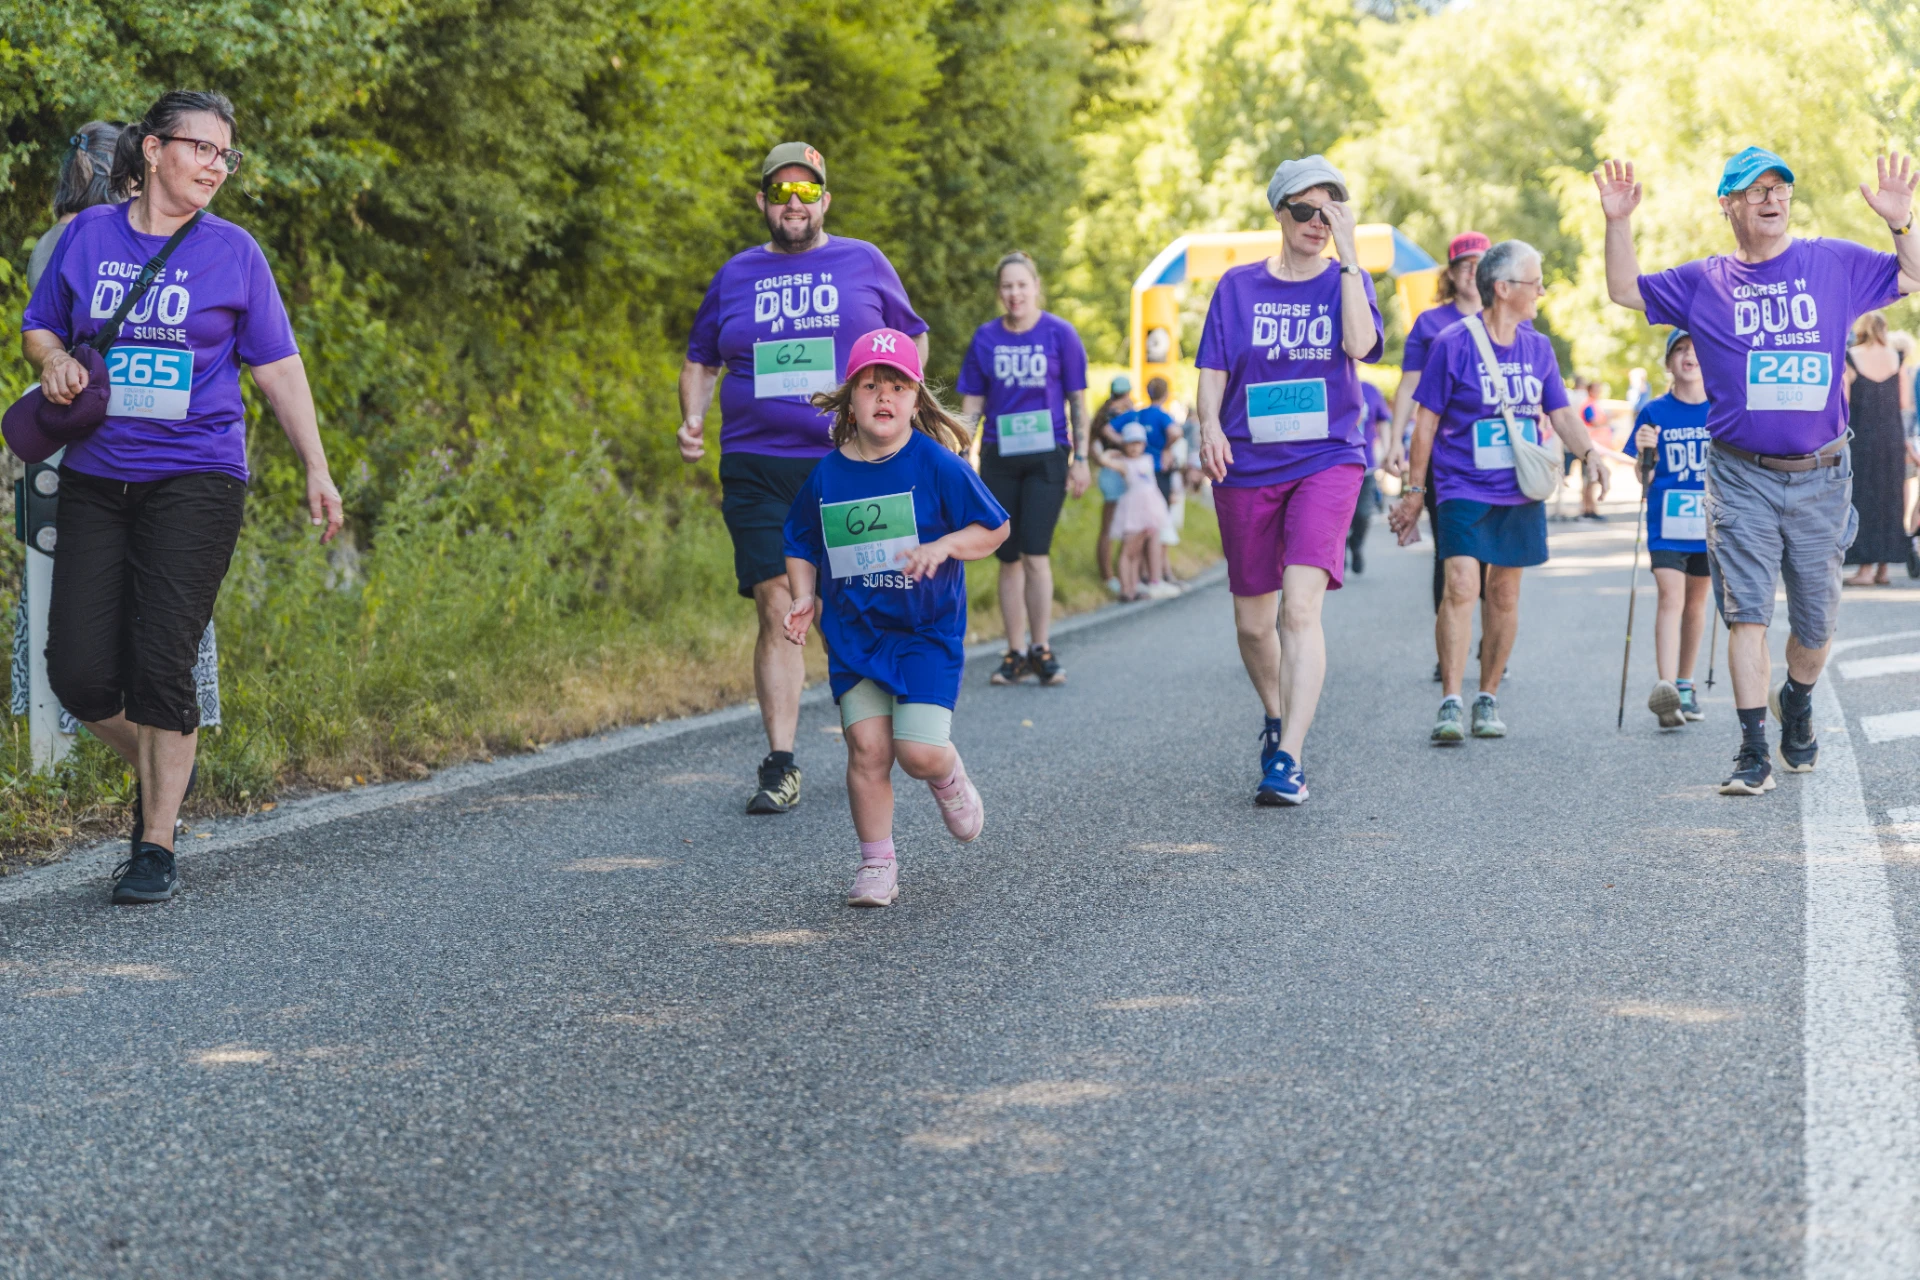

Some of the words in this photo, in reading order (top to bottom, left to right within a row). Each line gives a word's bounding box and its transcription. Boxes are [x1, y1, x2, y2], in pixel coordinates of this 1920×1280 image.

[98, 261, 166, 283] COURE
[755, 273, 813, 291] COURSE
[1733, 281, 1788, 299] COURSE
[90, 280, 190, 326] DUO
[755, 284, 839, 323] DUO
[1254, 303, 1311, 317] COURSE
[793, 314, 840, 331] SUISSE
[1735, 293, 1818, 335] DUO
[133, 326, 187, 343] SUISSE
[1252, 315, 1332, 349] DUO
[1775, 330, 1820, 346] SUISSE
[871, 333, 897, 353] NY
[776, 343, 812, 365] 62
[1289, 348, 1332, 360] SUISSE
[108, 352, 180, 387] 265
[994, 354, 1047, 379] DUO
[1758, 356, 1822, 384] 248
[123, 393, 155, 408] DUO
[1268, 386, 1314, 410] 248
[1011, 415, 1038, 433] 62
[1274, 420, 1300, 432] DUO
[846, 503, 887, 535] 62
[856, 549, 887, 567] DUO
[862, 573, 914, 590] SUISSE
